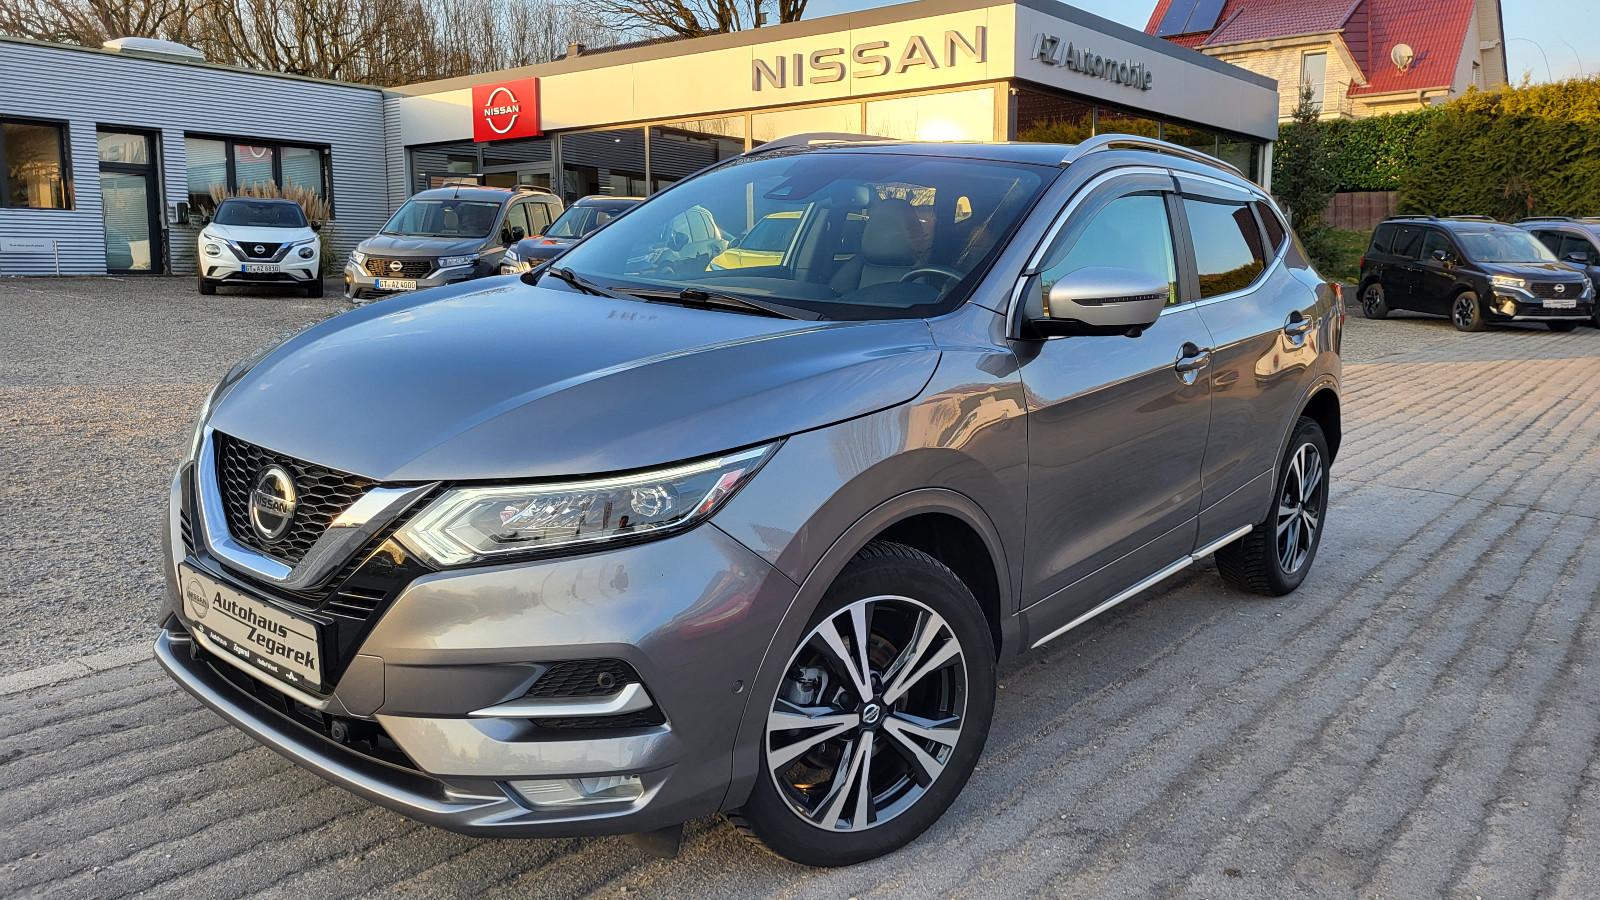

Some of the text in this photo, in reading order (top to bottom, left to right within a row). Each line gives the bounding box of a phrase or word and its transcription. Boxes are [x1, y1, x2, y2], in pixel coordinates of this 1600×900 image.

[752, 26, 987, 92] NISSAN
[1061, 41, 1153, 91] Automobile
[484, 104, 519, 117] NISSAN
[253, 490, 288, 514] NISSAN
[213, 591, 288, 639] Autohaus
[247, 626, 316, 671] Zegarek
